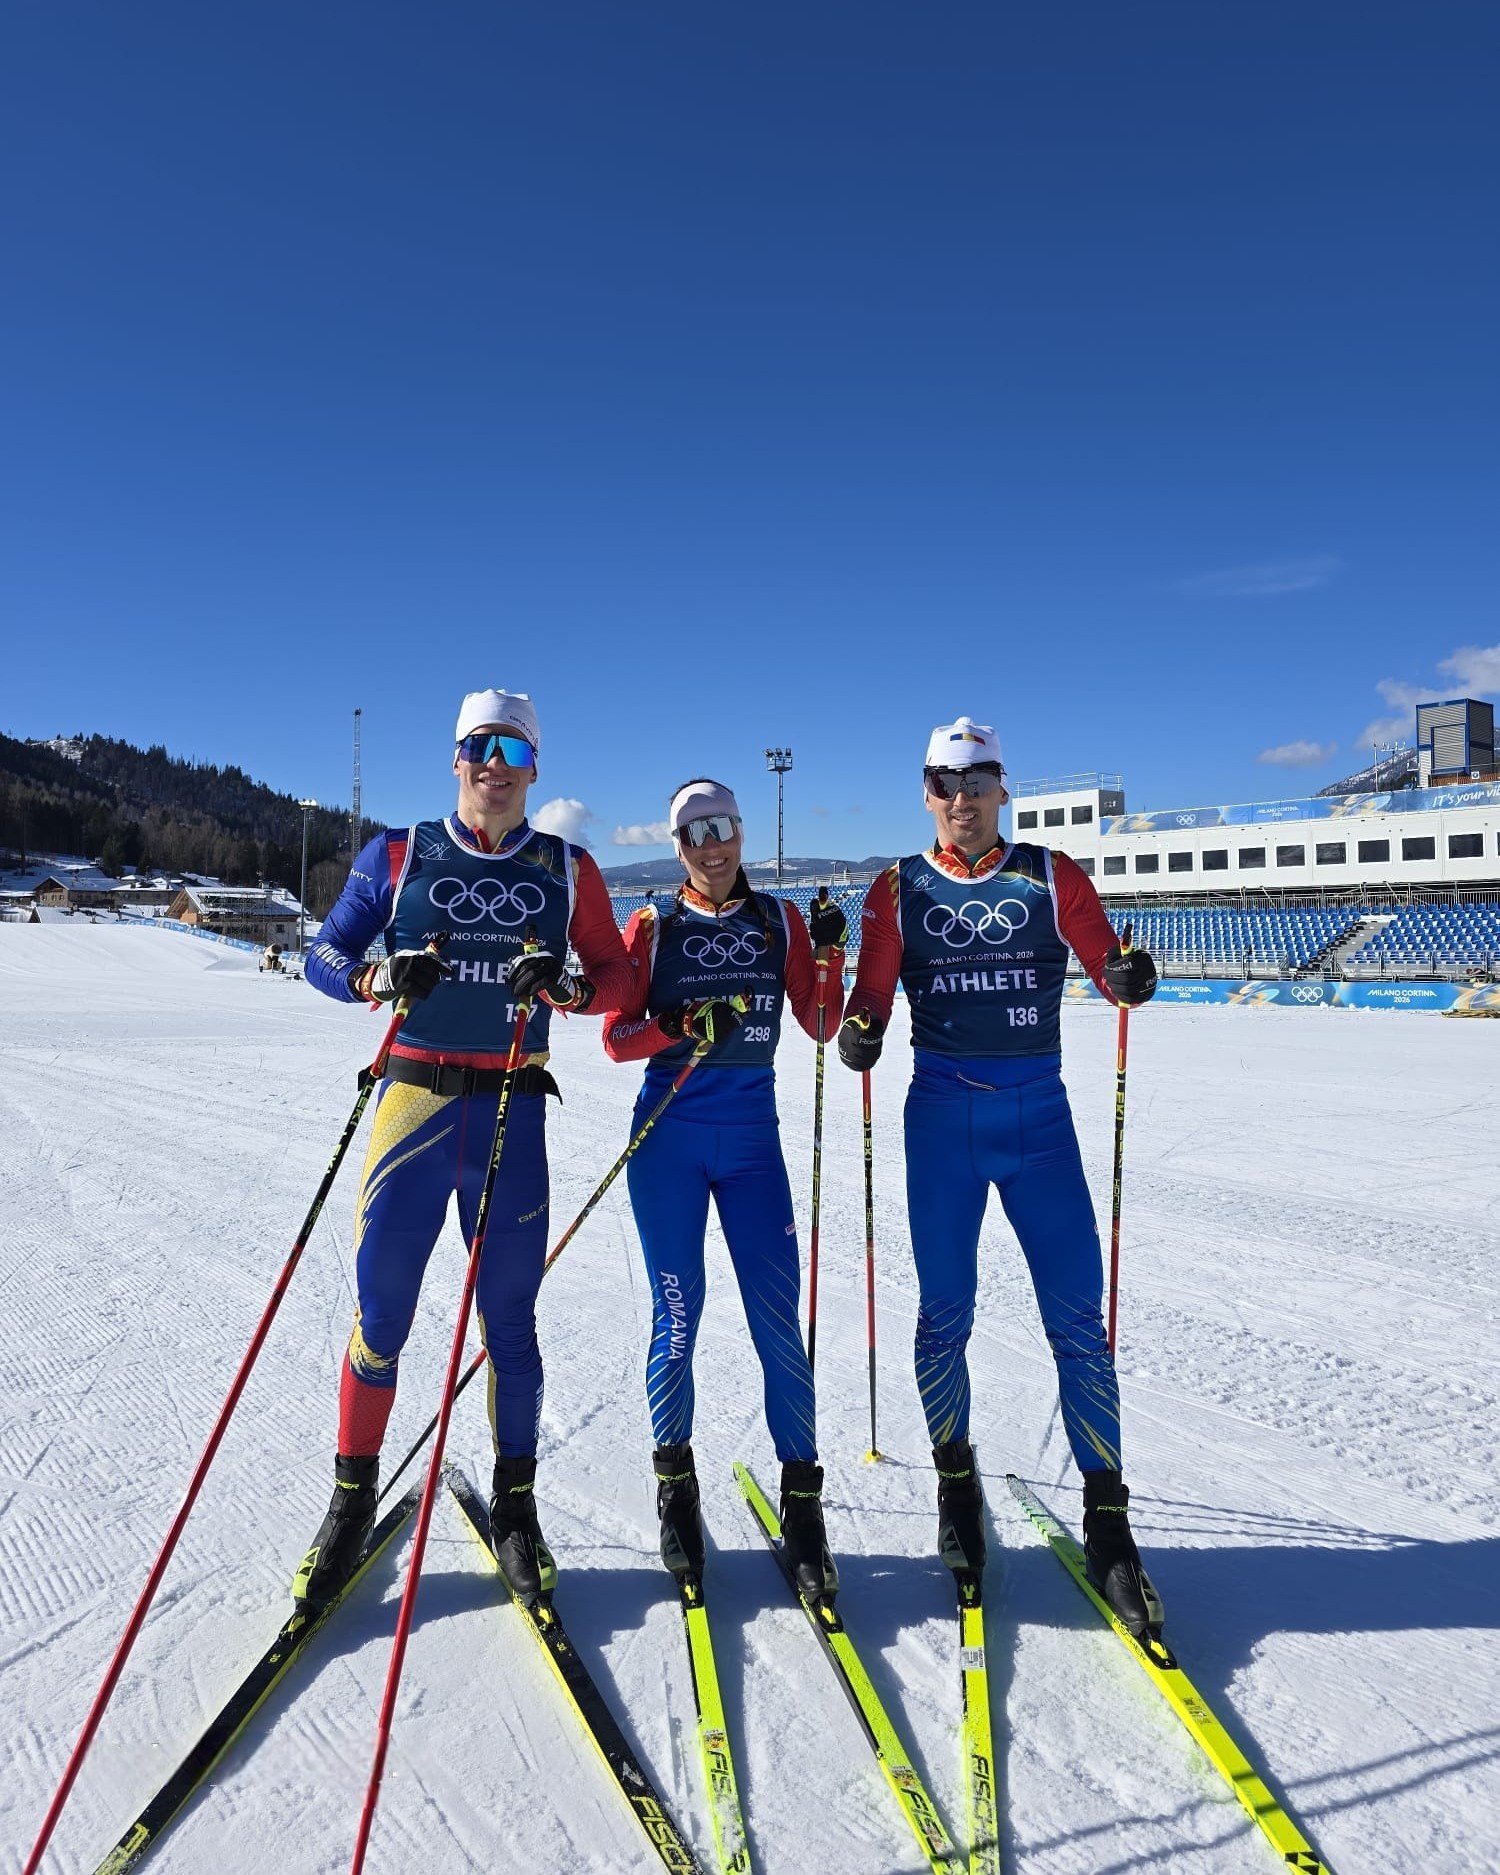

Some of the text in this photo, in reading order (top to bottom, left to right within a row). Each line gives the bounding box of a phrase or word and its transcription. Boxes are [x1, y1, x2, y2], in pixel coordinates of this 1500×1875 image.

[1455, 790, 1485, 806] your
[473, 933, 526, 945] CORTINA
[929, 949, 1034, 966] MILANO CORTINA 2026
[677, 972, 777, 984] MILANO CORTINA 2026
[930, 968, 1038, 994] ATHLETE
[505, 1003, 538, 1023] 17
[1007, 1006, 1039, 1027] 136
[744, 1026, 771, 1042] 298
[350, 1084, 373, 1126] LEKI
[496, 1079, 511, 1119] LEKI
[492, 1126, 506, 1169] LEKI
[660, 1271, 687, 1359] ROMANIA
